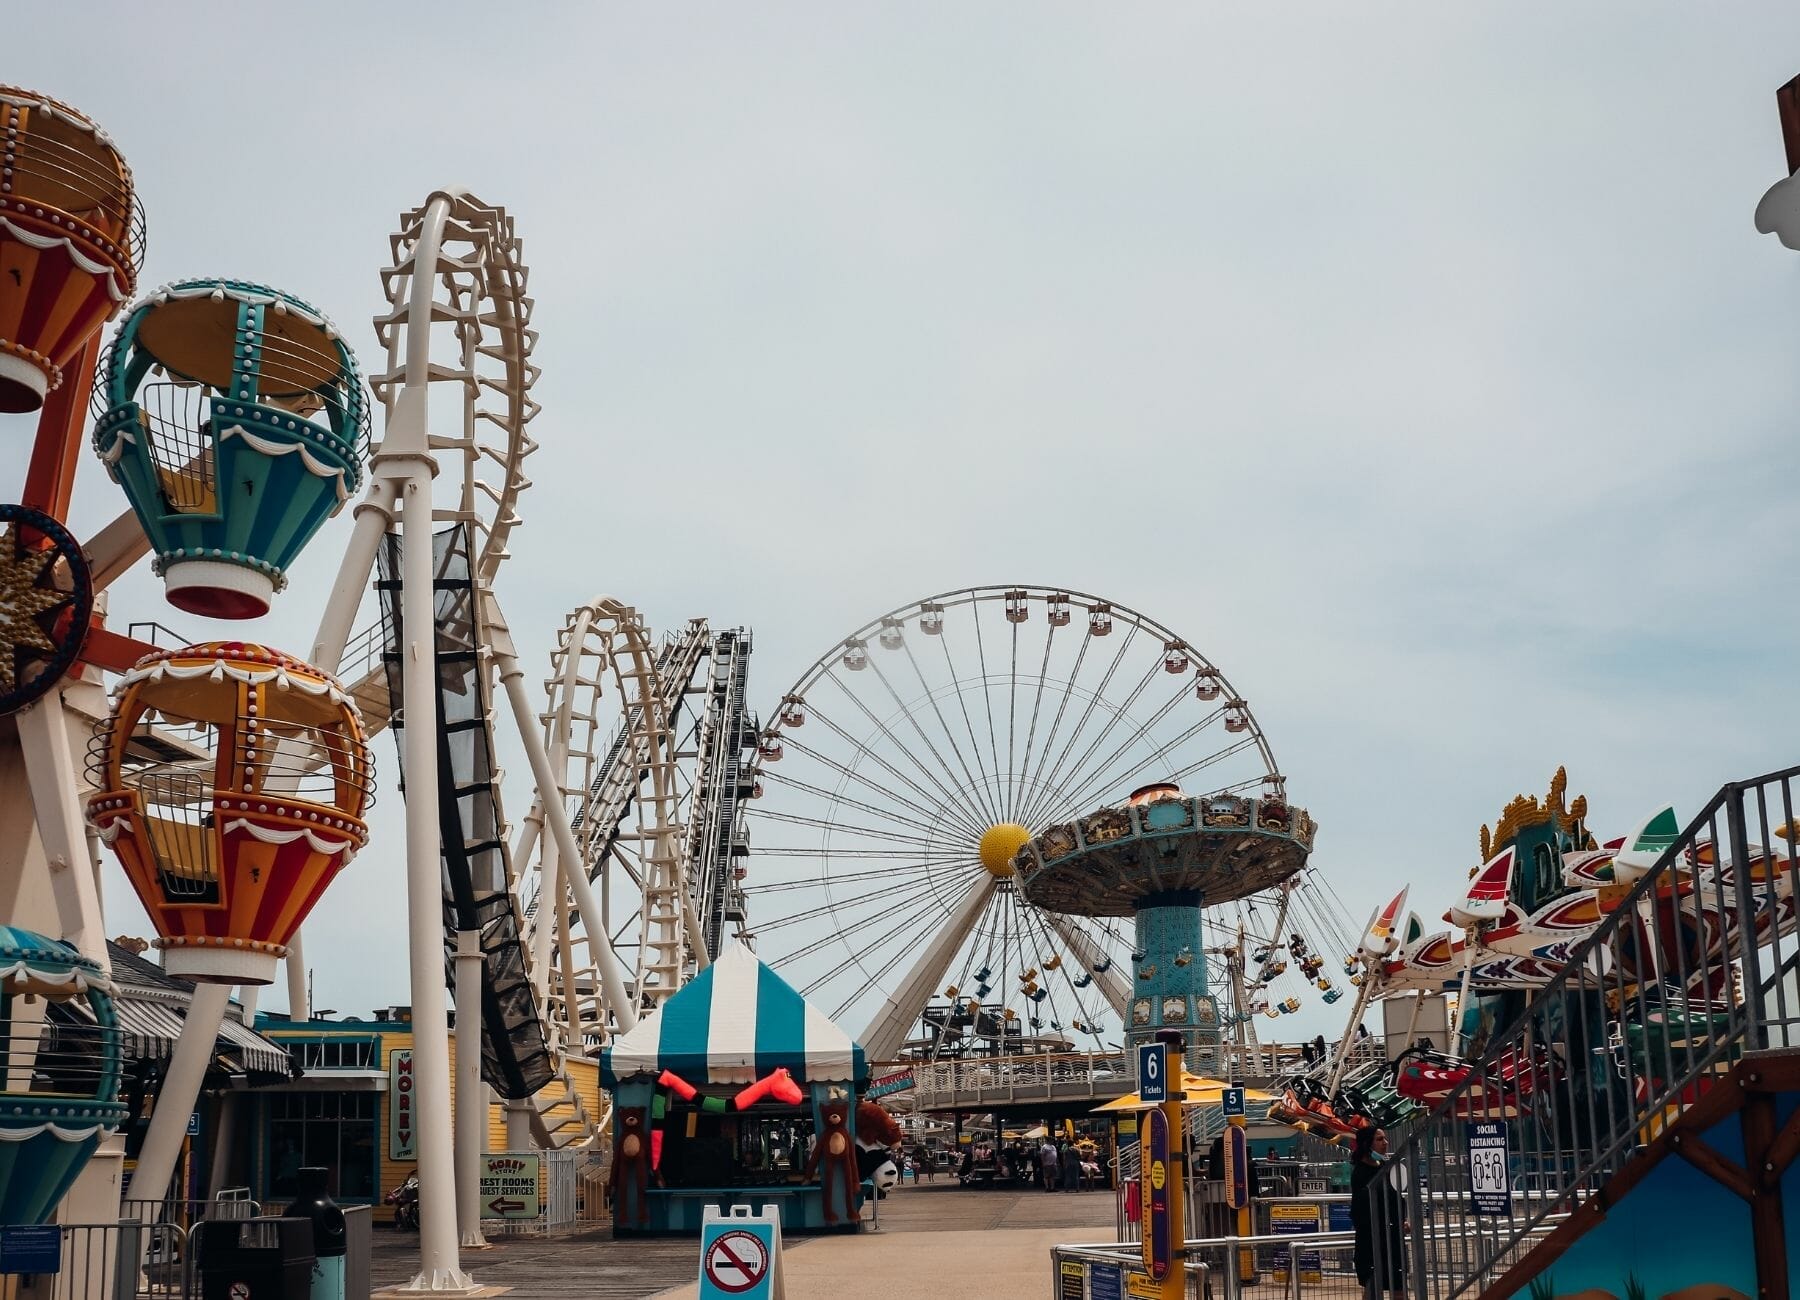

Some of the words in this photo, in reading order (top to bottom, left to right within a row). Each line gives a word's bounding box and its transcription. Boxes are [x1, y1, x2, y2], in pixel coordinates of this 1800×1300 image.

[1466, 894, 1492, 909] FLY
[1147, 1052, 1158, 1080] 6
[1144, 1085, 1162, 1095] Tickets
[398, 1058, 412, 1147] MOREY
[1229, 1091, 1237, 1105] 5
[1477, 1125, 1497, 1134] SOCIAL
[1470, 1137, 1505, 1147] DISTANCING
[502, 1177, 535, 1187] ROOMS
[1301, 1182, 1323, 1191] ENTER
[501, 1187, 535, 1196] SERVICES
[1062, 1264, 1083, 1274] ATTENTION
